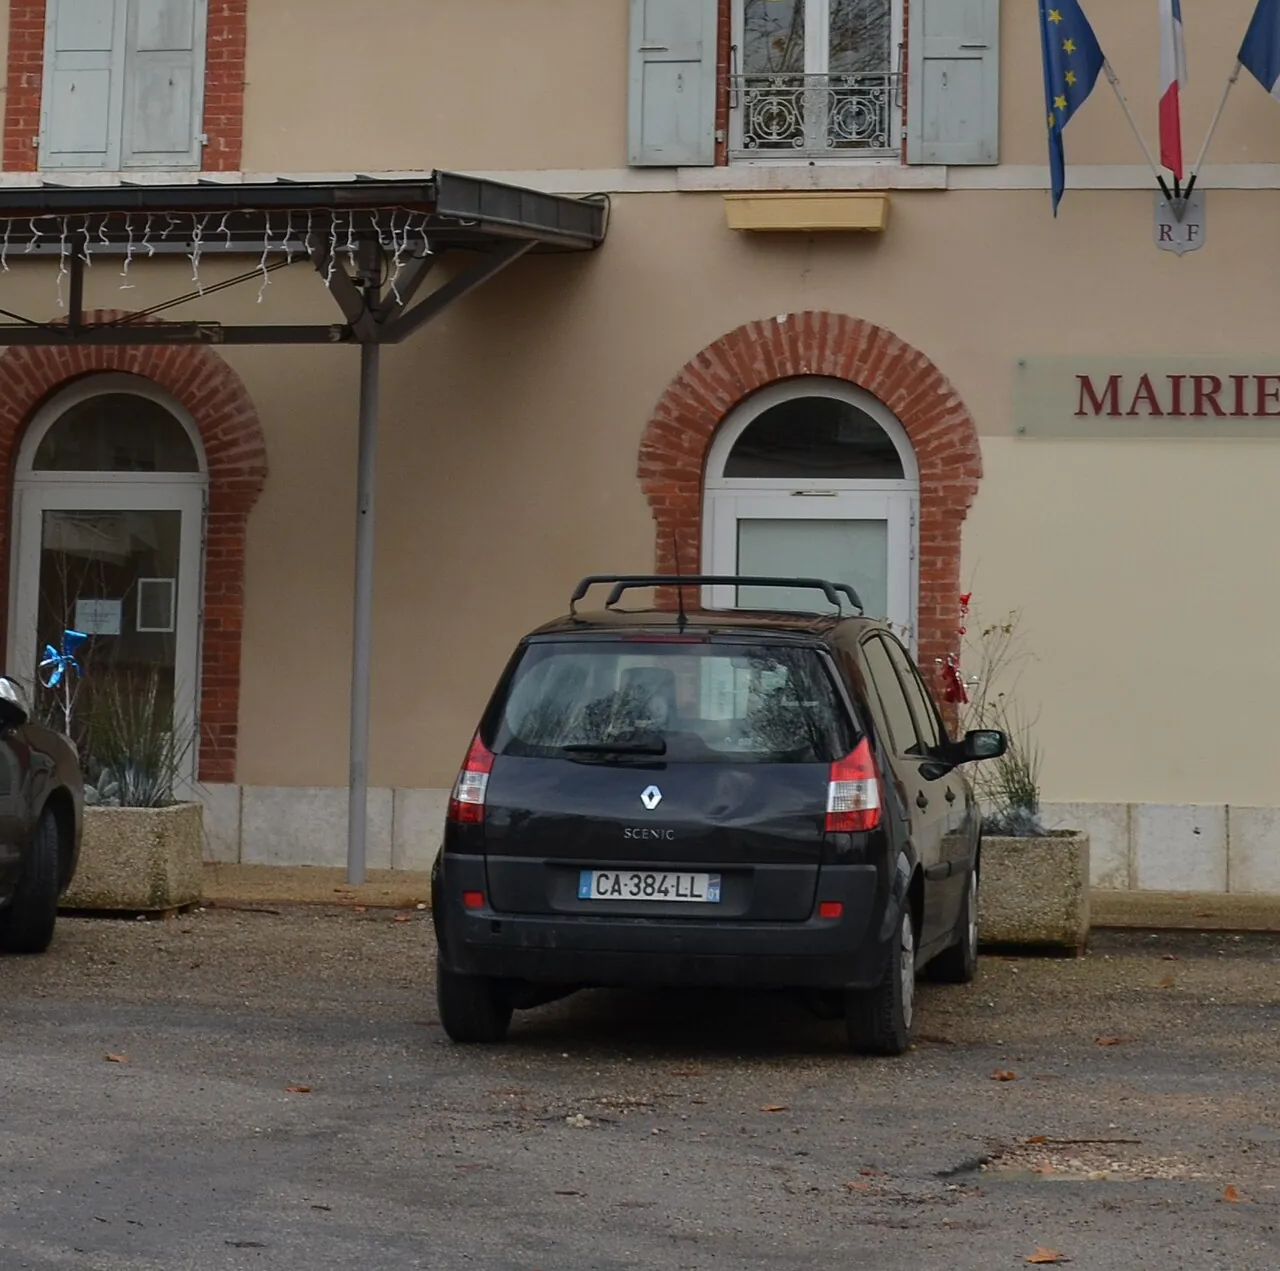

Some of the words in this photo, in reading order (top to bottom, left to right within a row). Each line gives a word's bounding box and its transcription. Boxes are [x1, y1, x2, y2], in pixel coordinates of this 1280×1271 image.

[1159, 223, 1173, 242] R
[1186, 223, 1200, 242] F
[623, 828, 675, 841] SCENIC
[596, 873, 703, 899] CA-384-LL
